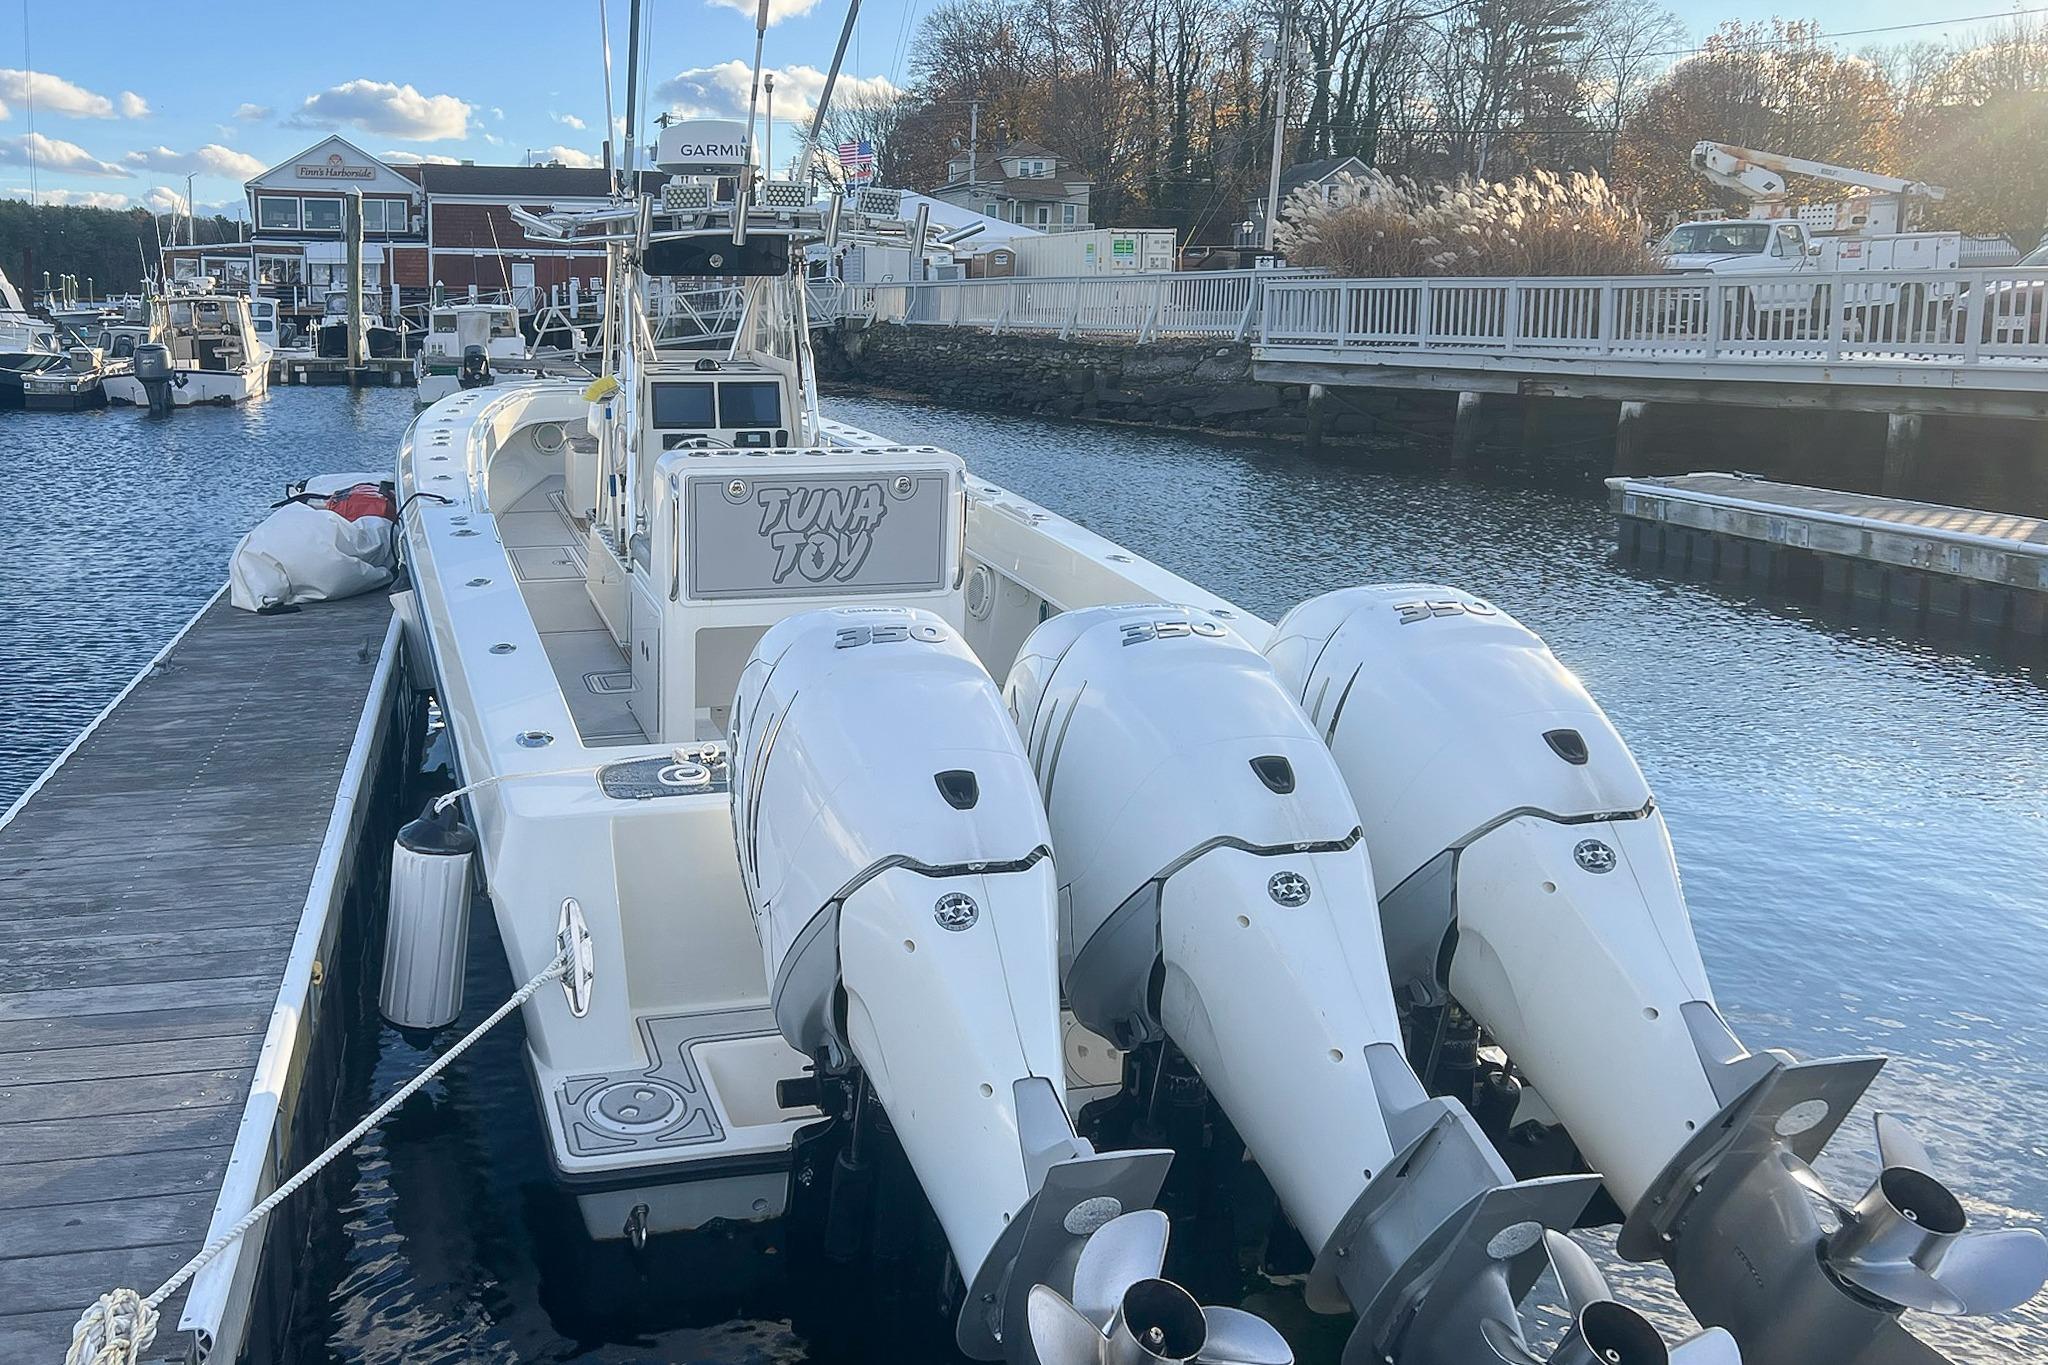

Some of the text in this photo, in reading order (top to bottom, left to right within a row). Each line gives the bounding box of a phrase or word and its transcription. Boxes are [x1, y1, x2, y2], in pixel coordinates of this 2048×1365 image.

[680, 144, 748, 156] GARMIN
[300, 166, 371, 177] Finn's Harborside
[757, 483, 888, 536] TUNA
[771, 530, 873, 584] TOY
[1393, 600, 1497, 625] 350
[834, 624, 949, 649] 350
[1119, 621, 1227, 646] 350
